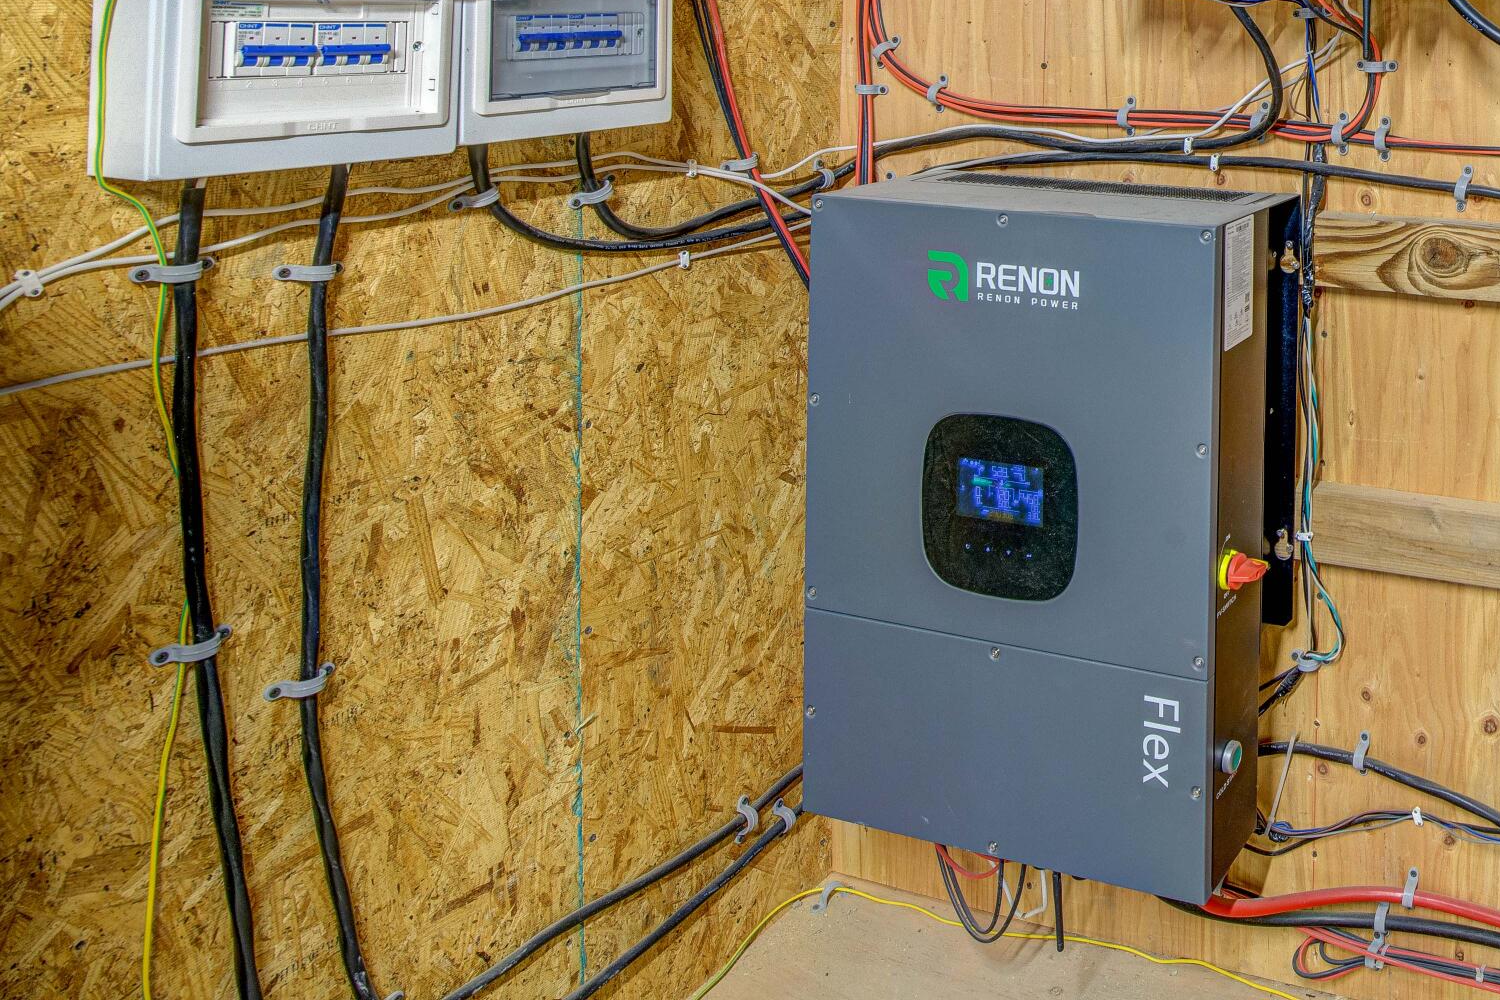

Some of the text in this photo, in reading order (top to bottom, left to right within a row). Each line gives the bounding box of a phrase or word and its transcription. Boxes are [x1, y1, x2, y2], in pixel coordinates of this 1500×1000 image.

[976, 262, 1080, 298] RENON
[977, 292, 1079, 310] RENON POWER
[1142, 695, 1181, 788] Flex
